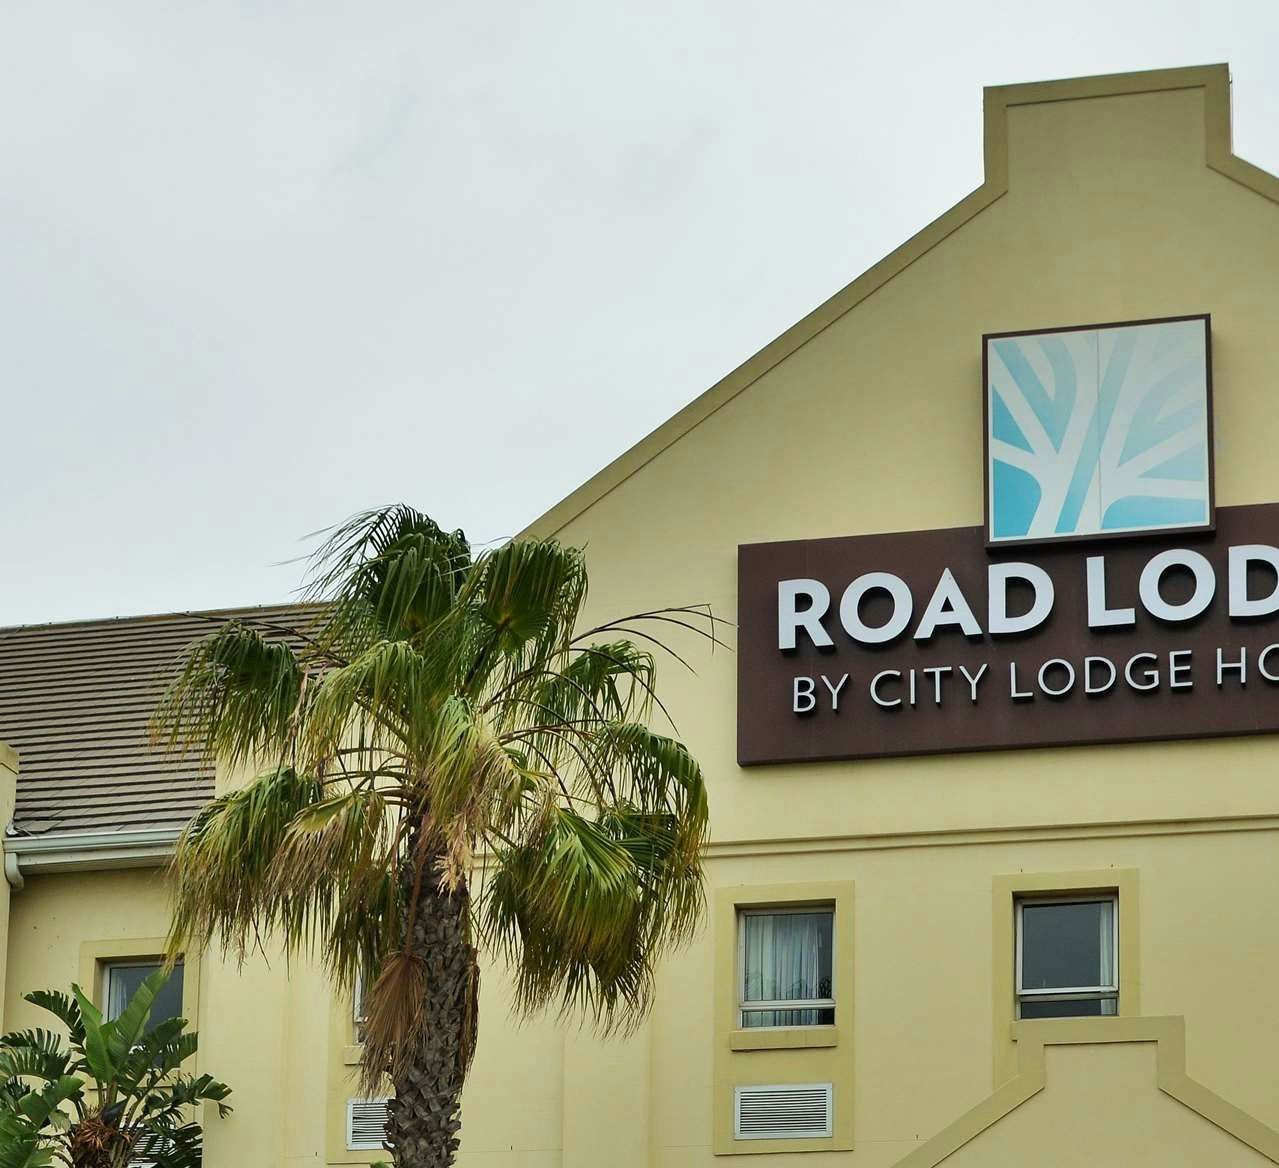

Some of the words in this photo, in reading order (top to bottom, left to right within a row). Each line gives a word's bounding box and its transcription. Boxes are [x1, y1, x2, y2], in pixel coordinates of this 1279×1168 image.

[777, 562, 1055, 650] ROAD
[792, 673, 851, 713] BY
[869, 662, 989, 707] CITY
[1010, 649, 1194, 698] LODGE
